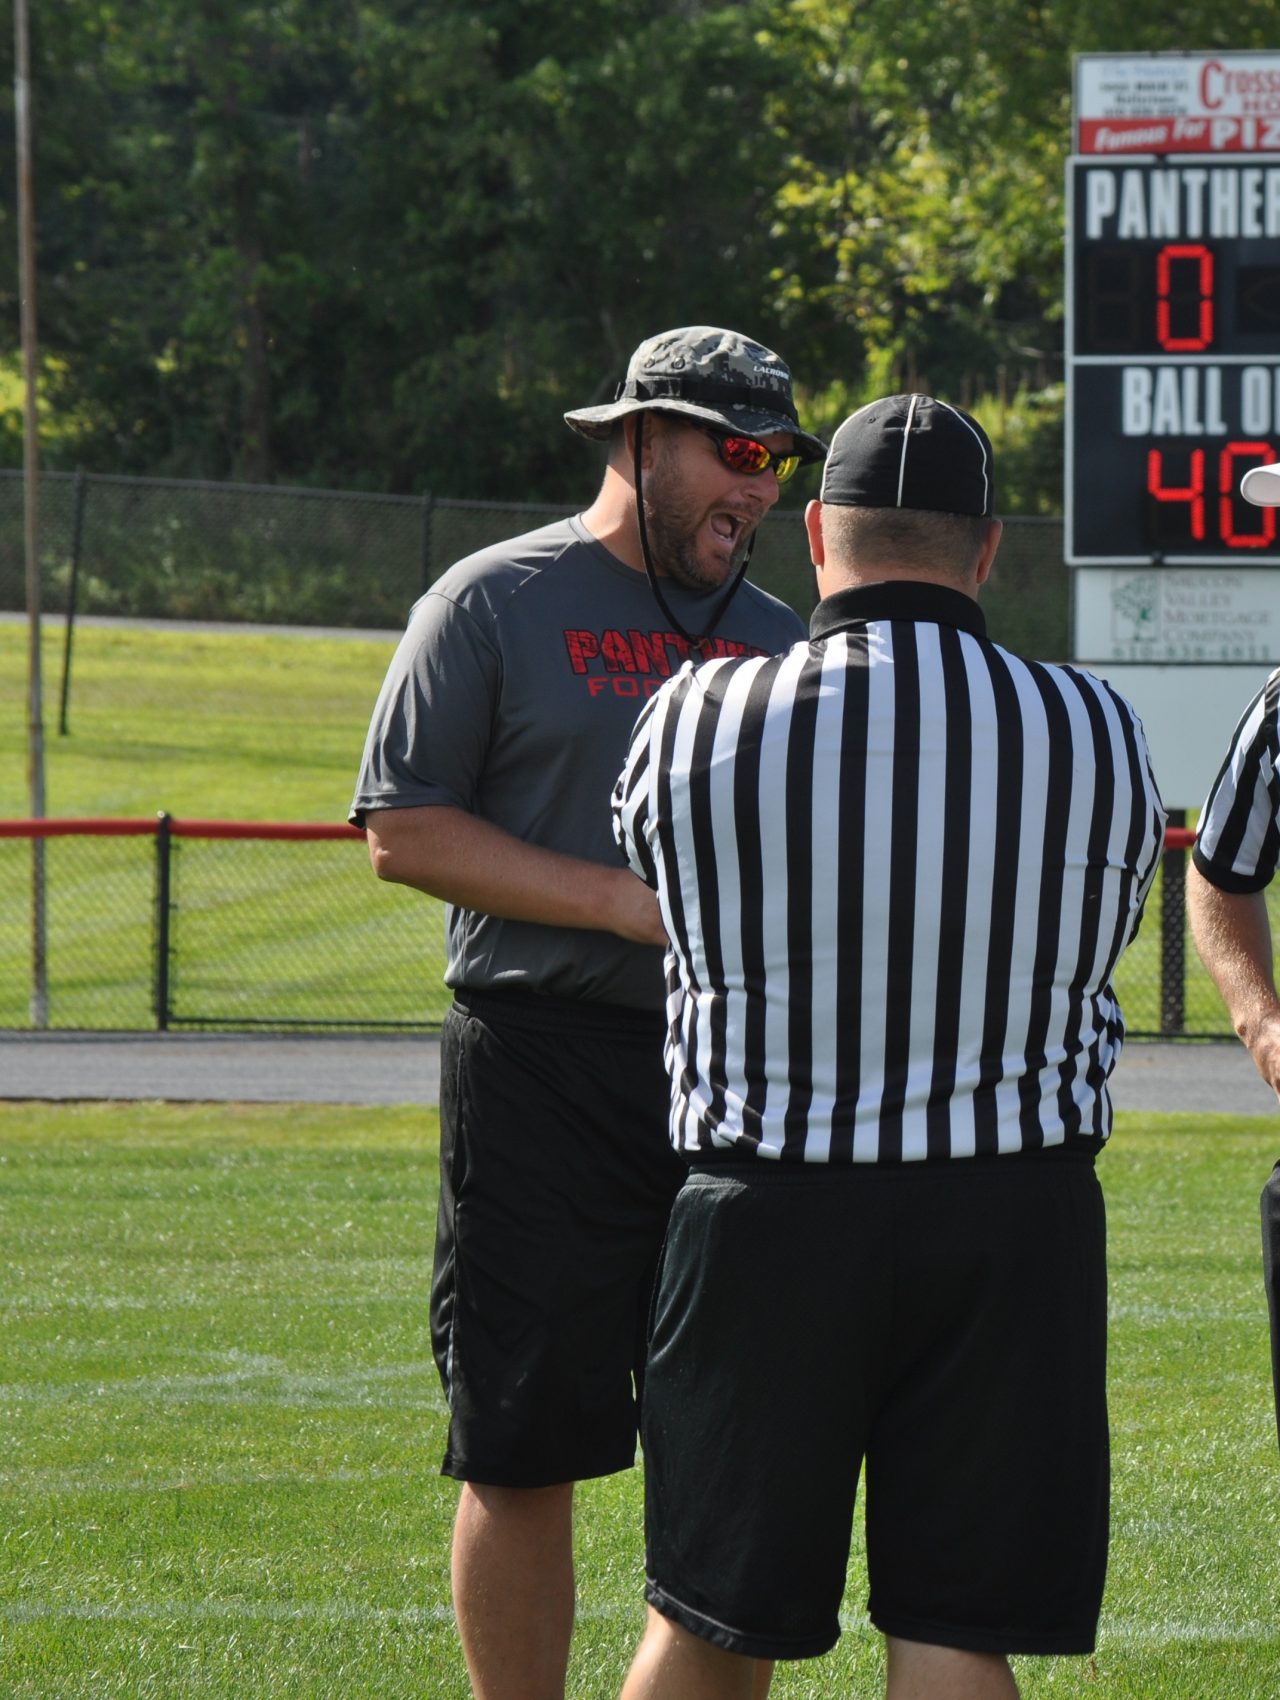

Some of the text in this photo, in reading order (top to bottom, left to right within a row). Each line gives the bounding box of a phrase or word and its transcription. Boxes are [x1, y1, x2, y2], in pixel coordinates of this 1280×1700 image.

[1094, 123, 1168, 151] Famous
[1172, 118, 1205, 141] For
[1157, 244, 1214, 350] 0
[1122, 366, 1228, 436] BALL
[1147, 441, 1277, 548] 40
[1162, 609, 1272, 625] MORTGAGE
[1163, 590, 1231, 606] VALLEY
